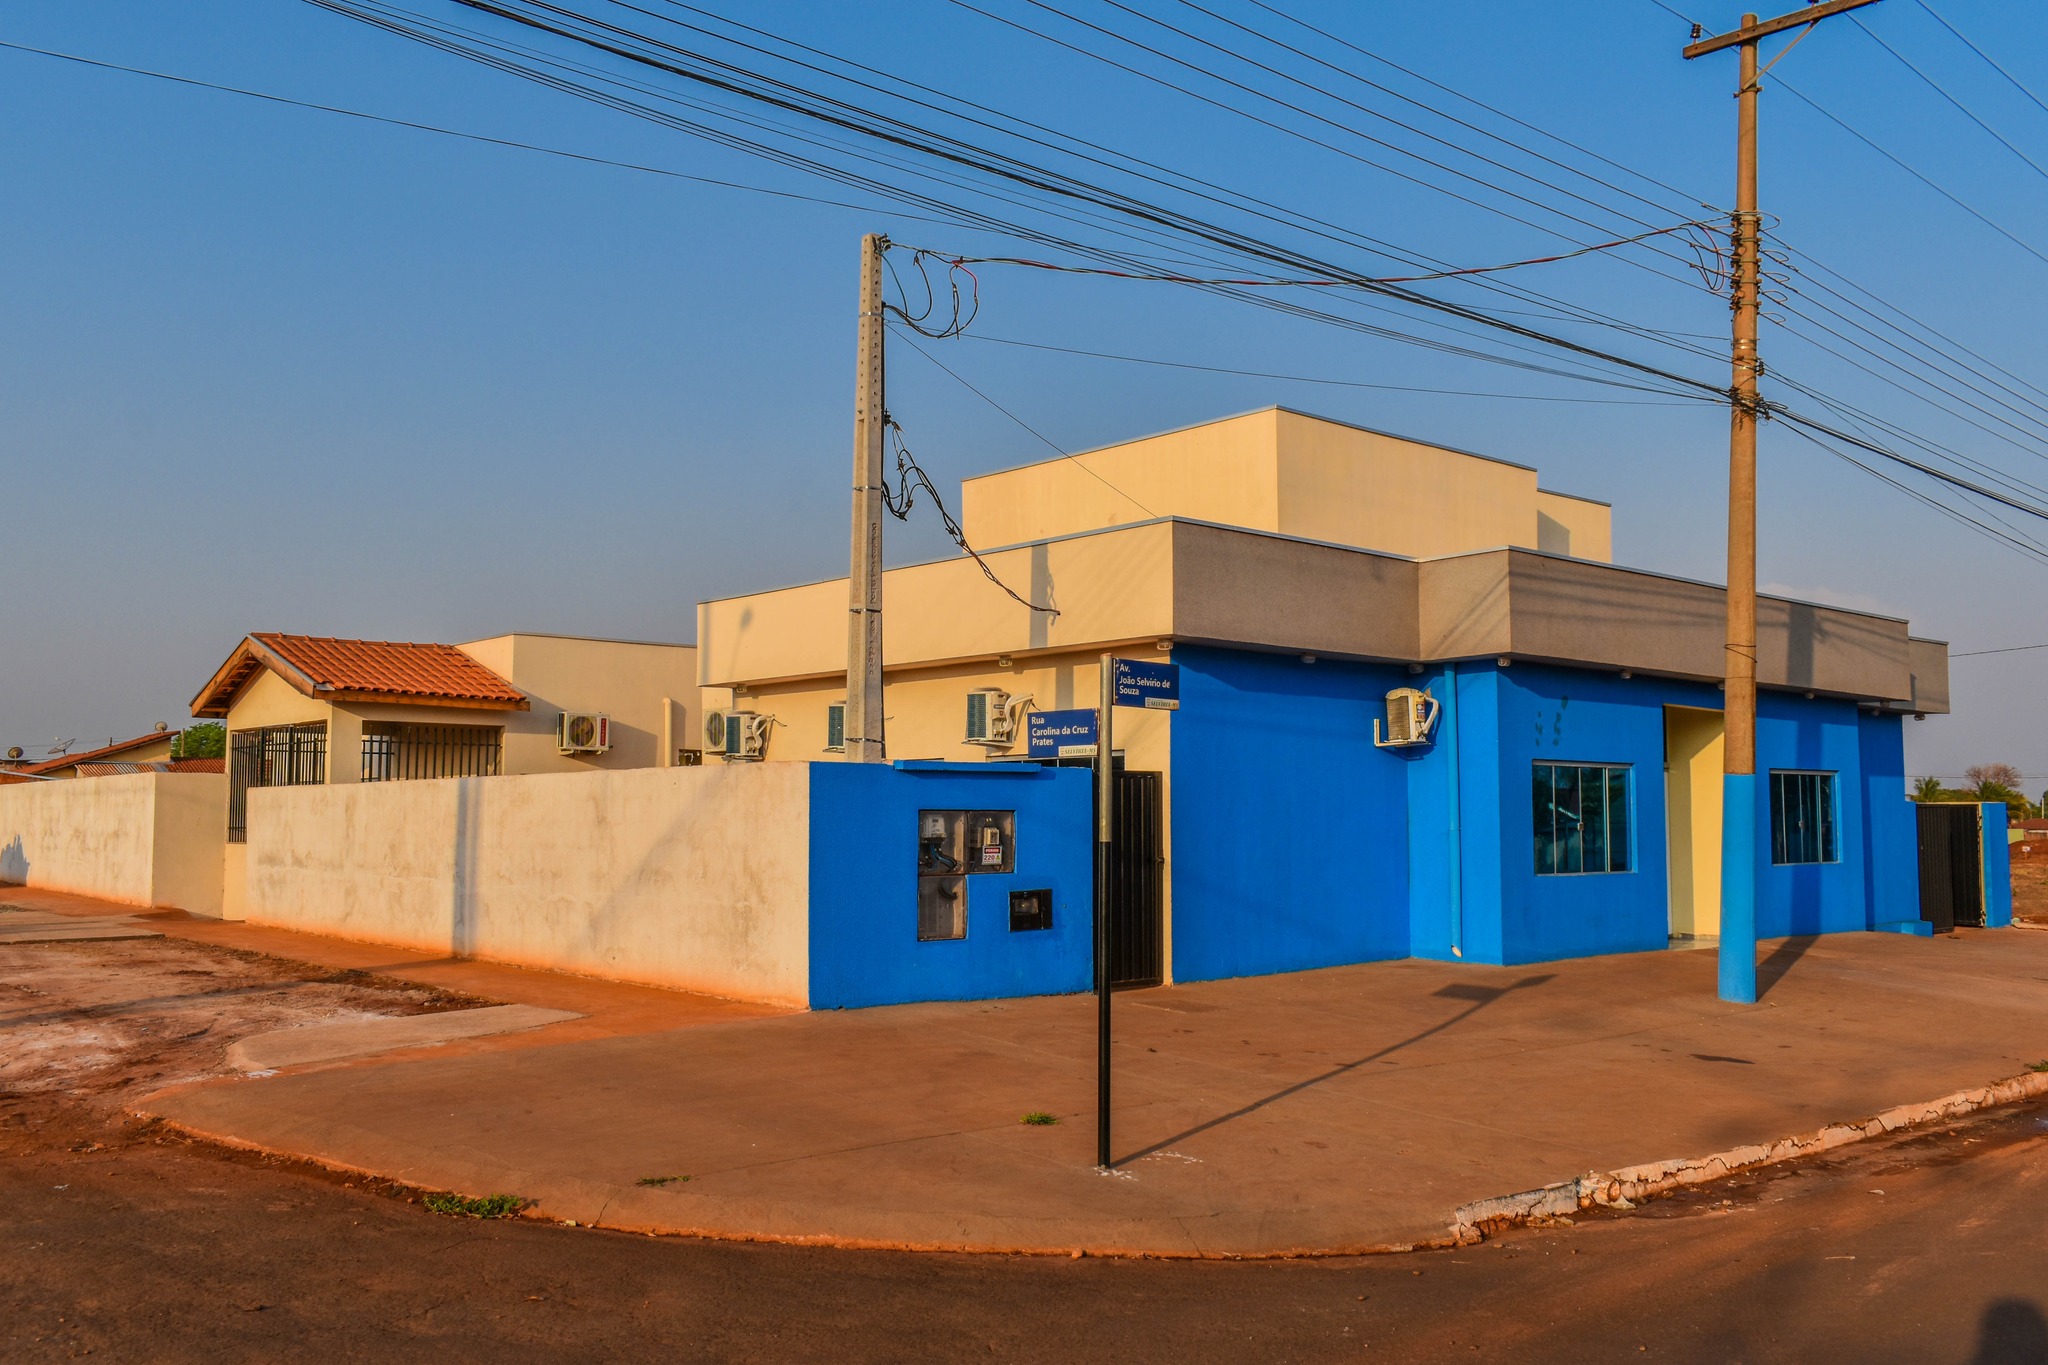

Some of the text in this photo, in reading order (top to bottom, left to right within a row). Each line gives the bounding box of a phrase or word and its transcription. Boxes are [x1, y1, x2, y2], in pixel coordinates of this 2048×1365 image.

[1120, 663, 1130, 672] Av.
[1119, 675, 1135, 685] João
[1162, 680, 1170, 688] de
[1119, 685, 1139, 695] Souza
[1031, 716, 1045, 725] Rua
[1031, 725, 1089, 736] Carolina da Cruz
[1032, 738, 1053, 746] Prates
